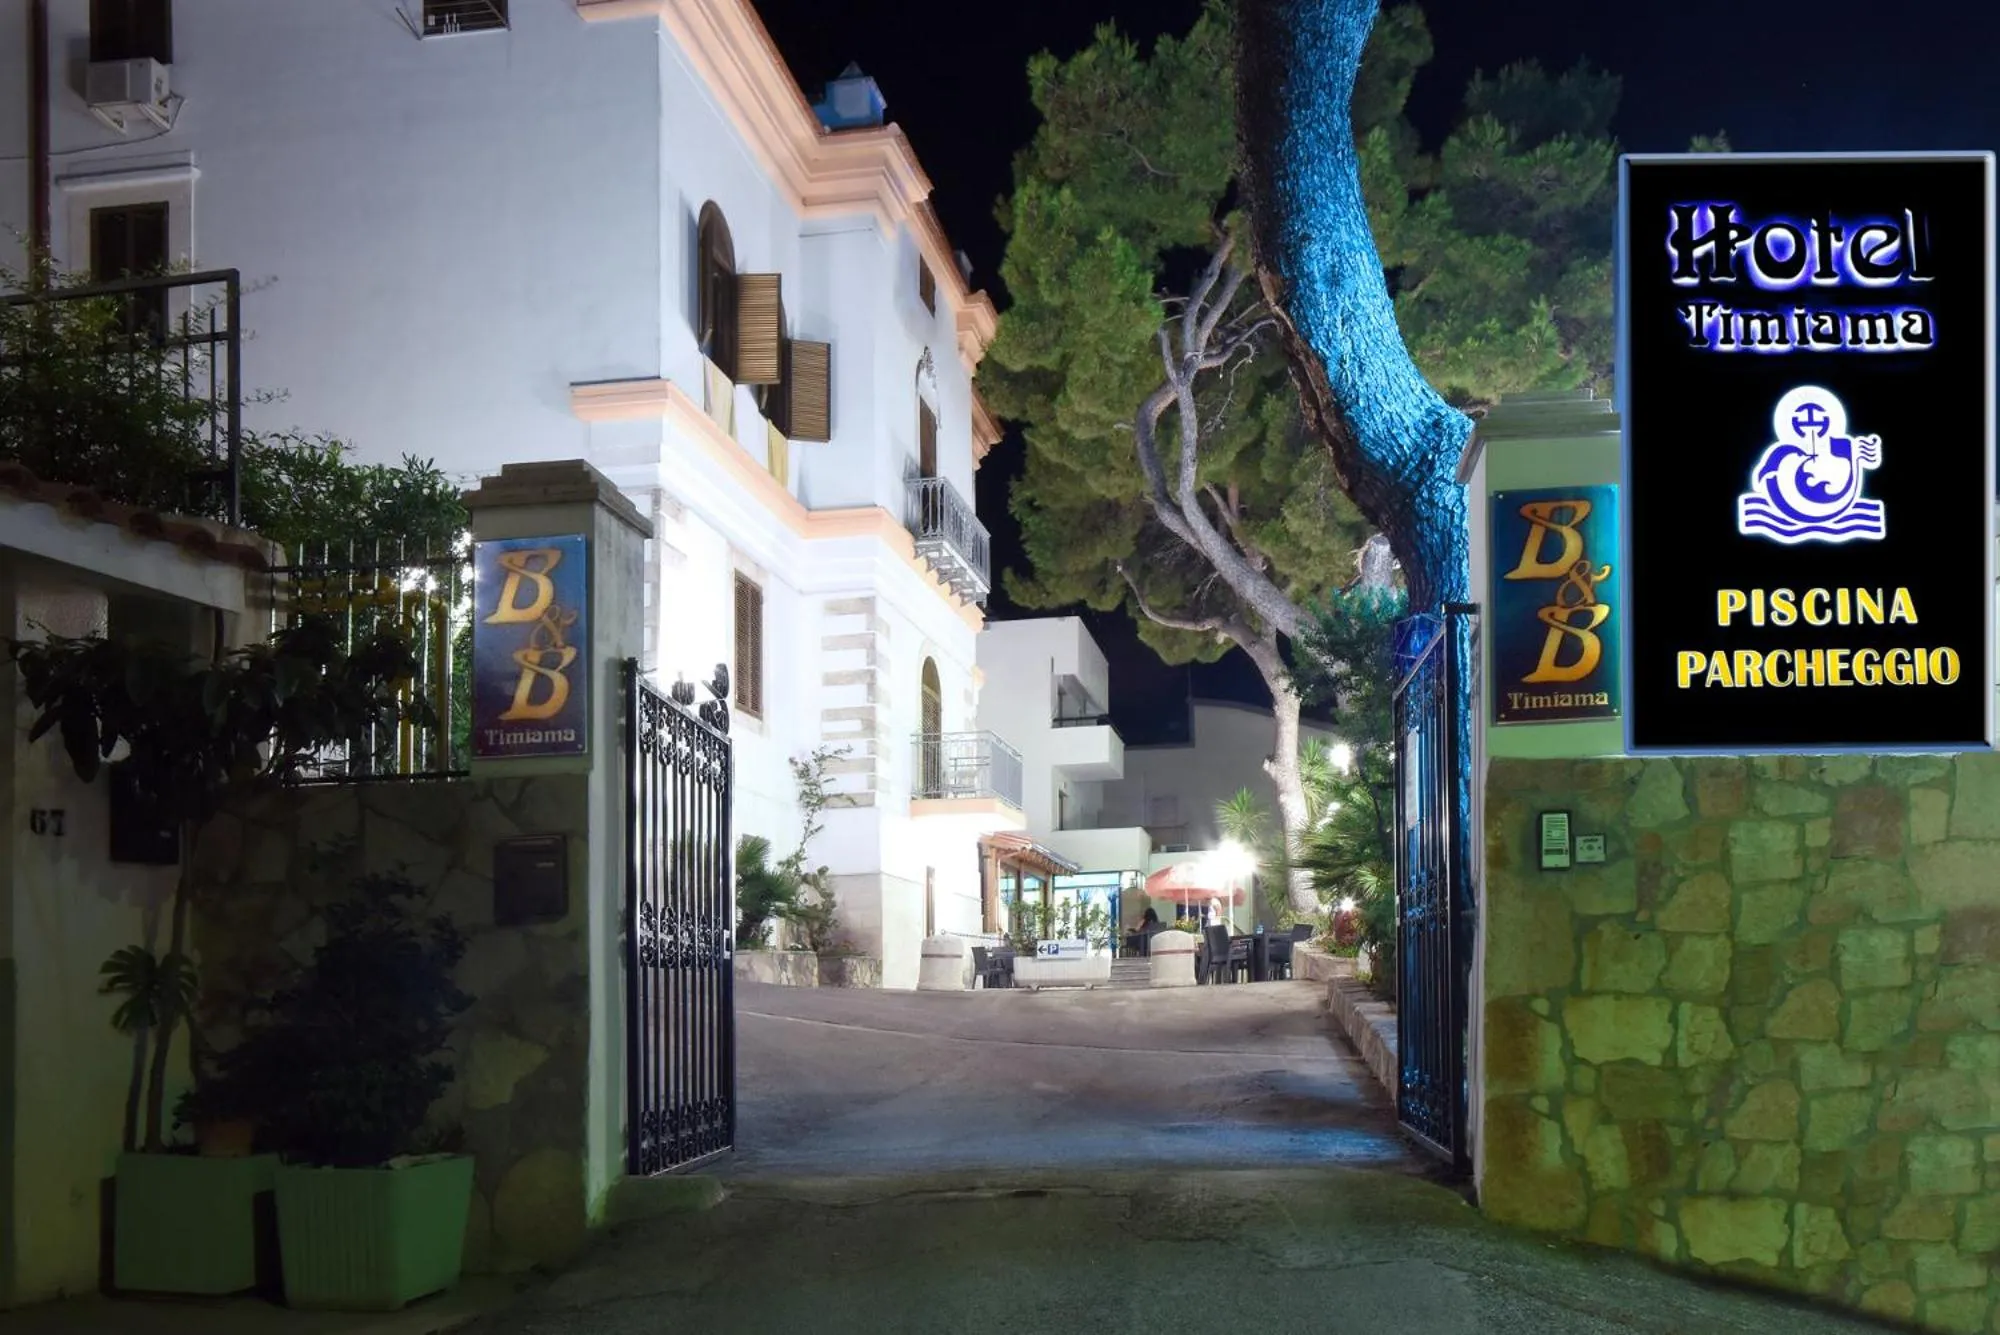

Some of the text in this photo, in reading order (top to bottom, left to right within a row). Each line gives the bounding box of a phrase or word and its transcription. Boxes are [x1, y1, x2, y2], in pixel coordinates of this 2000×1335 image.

[1667, 203, 1936, 287] Hotel
[1677, 301, 1935, 350] Timiama
[1716, 587, 1919, 626] PISCINA
[1677, 646, 1961, 688] PARCHEGGIO
[1507, 691, 1609, 709] Timiama
[484, 728, 576, 746] Timiama
